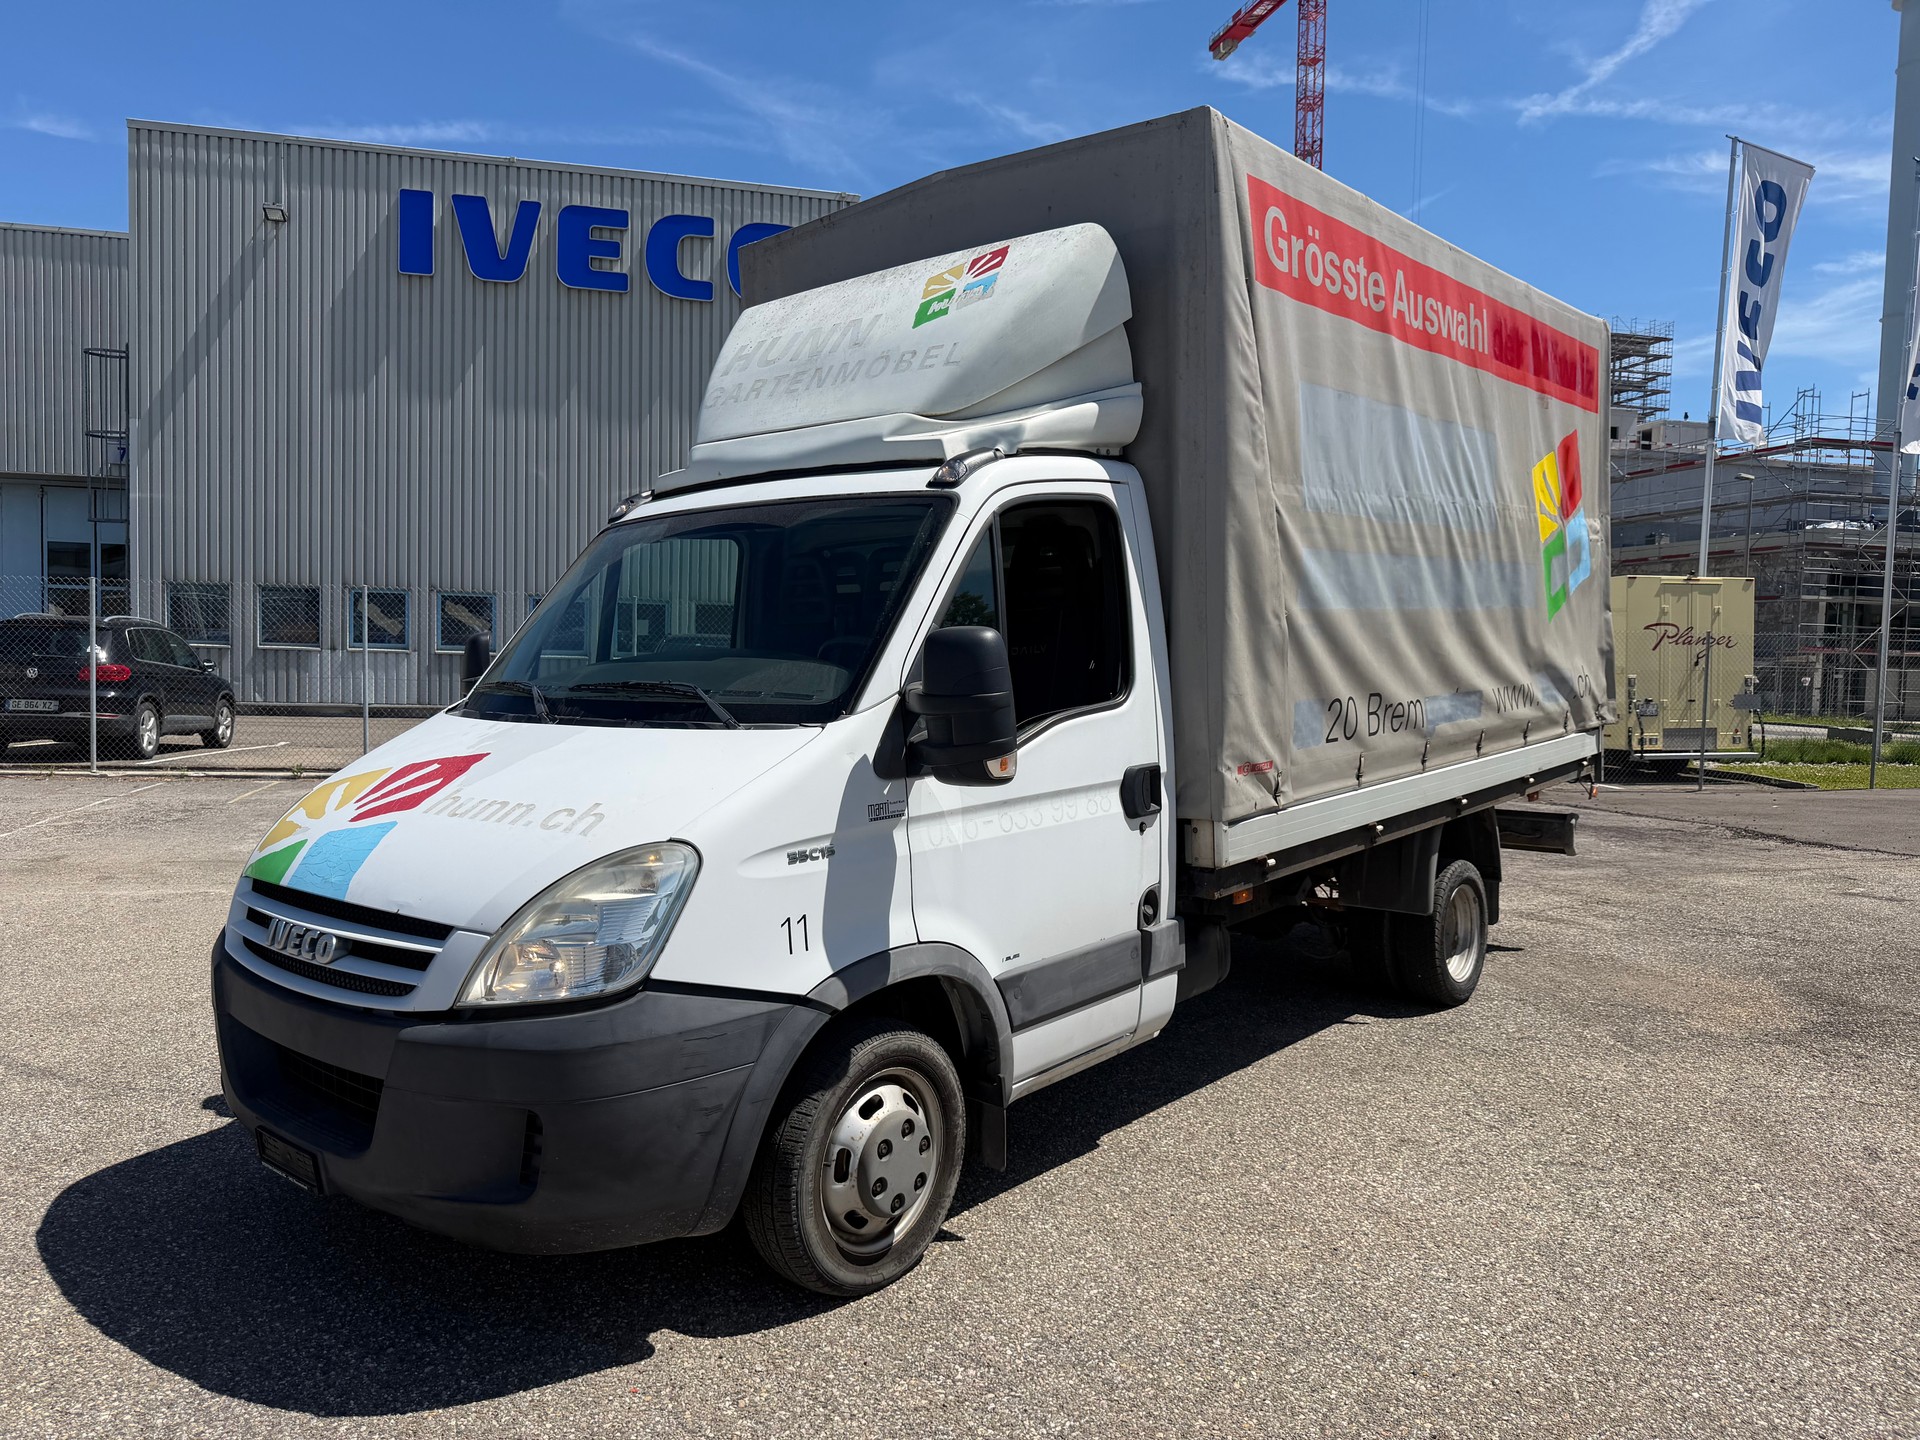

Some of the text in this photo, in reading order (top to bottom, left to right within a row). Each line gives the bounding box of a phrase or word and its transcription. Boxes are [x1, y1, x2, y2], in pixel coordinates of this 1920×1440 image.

[1263, 206, 1489, 355] Grösste Auswahl
[720, 313, 884, 378] HUNN
[703, 341, 962, 410] GARTENMÖBEL
[422, 786, 606, 837] hunn.ch
[786, 843, 836, 866] 35C15
[266, 918, 337, 964] IVECO
[780, 913, 809, 955] 11
